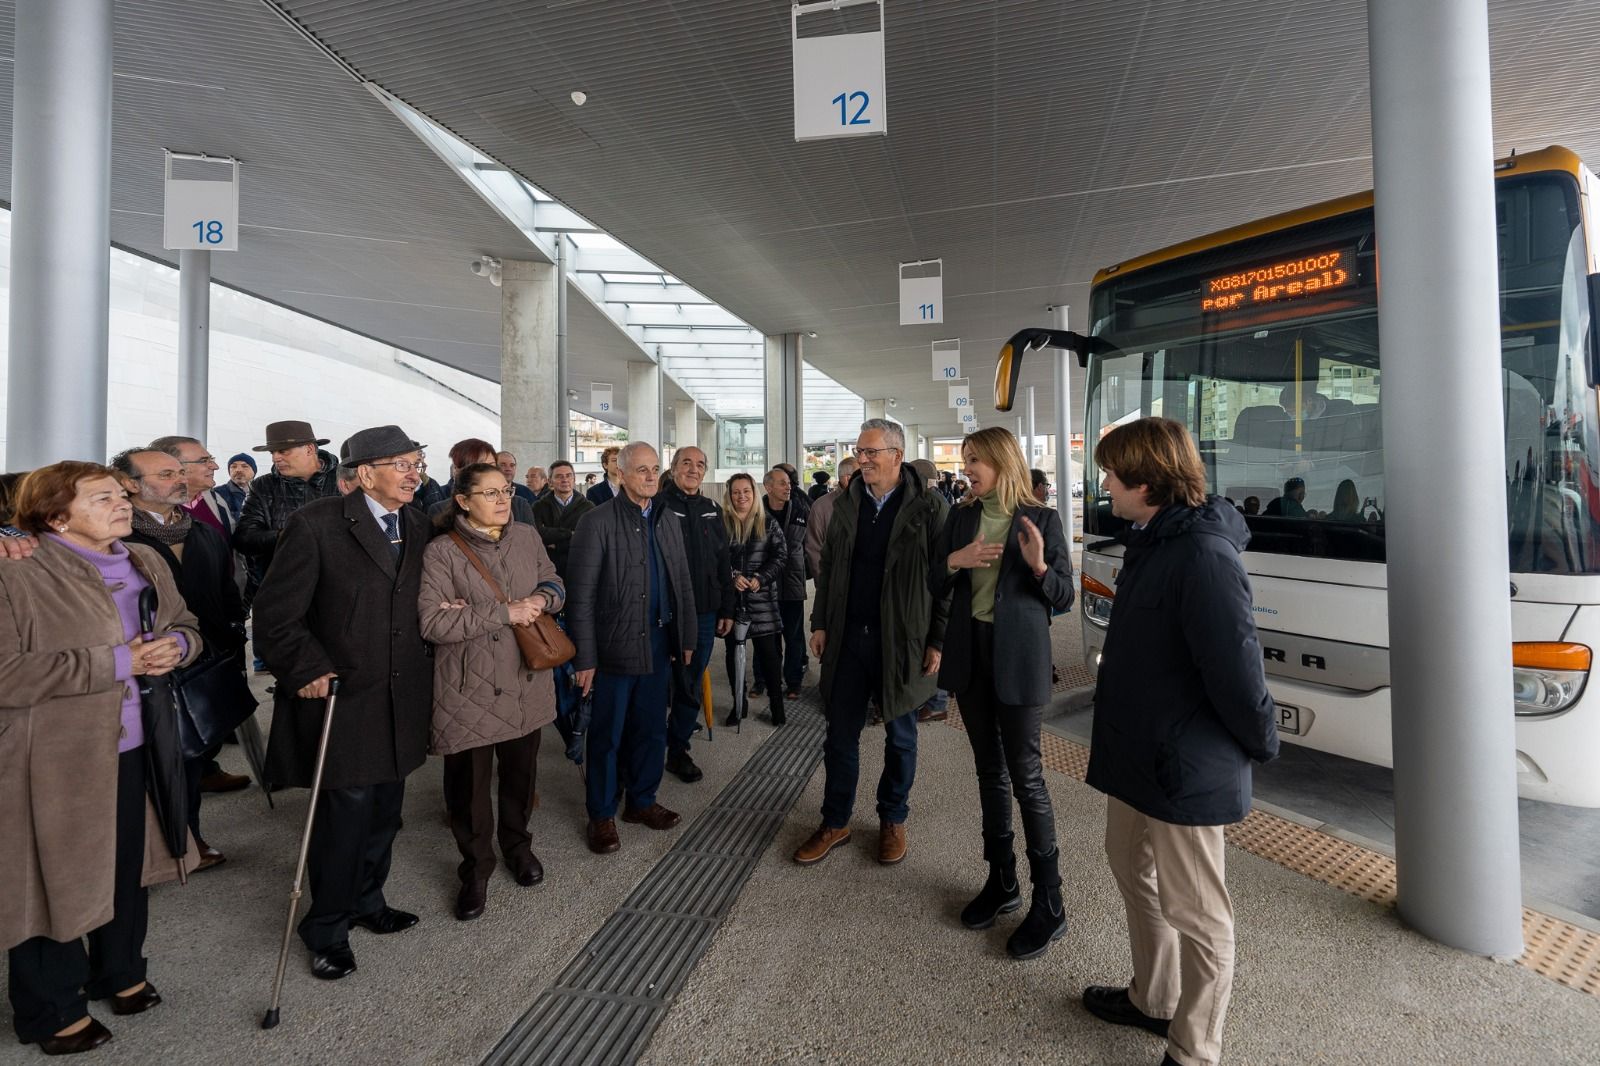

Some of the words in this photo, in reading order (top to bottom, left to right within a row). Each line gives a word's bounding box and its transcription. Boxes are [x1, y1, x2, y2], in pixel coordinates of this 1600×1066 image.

[832, 91, 871, 125] 12
[192, 220, 223, 244] 18
[1209, 252, 1341, 293] XG81701501007
[919, 303, 934, 320] 11
[944, 367, 957, 378] 10
[600, 402, 610, 411] 19
[956, 397, 968, 406] 09
[1252, 605, 1278, 615] úblico
[1263, 646, 1326, 670] RA
[1276, 708, 1292, 725] P
